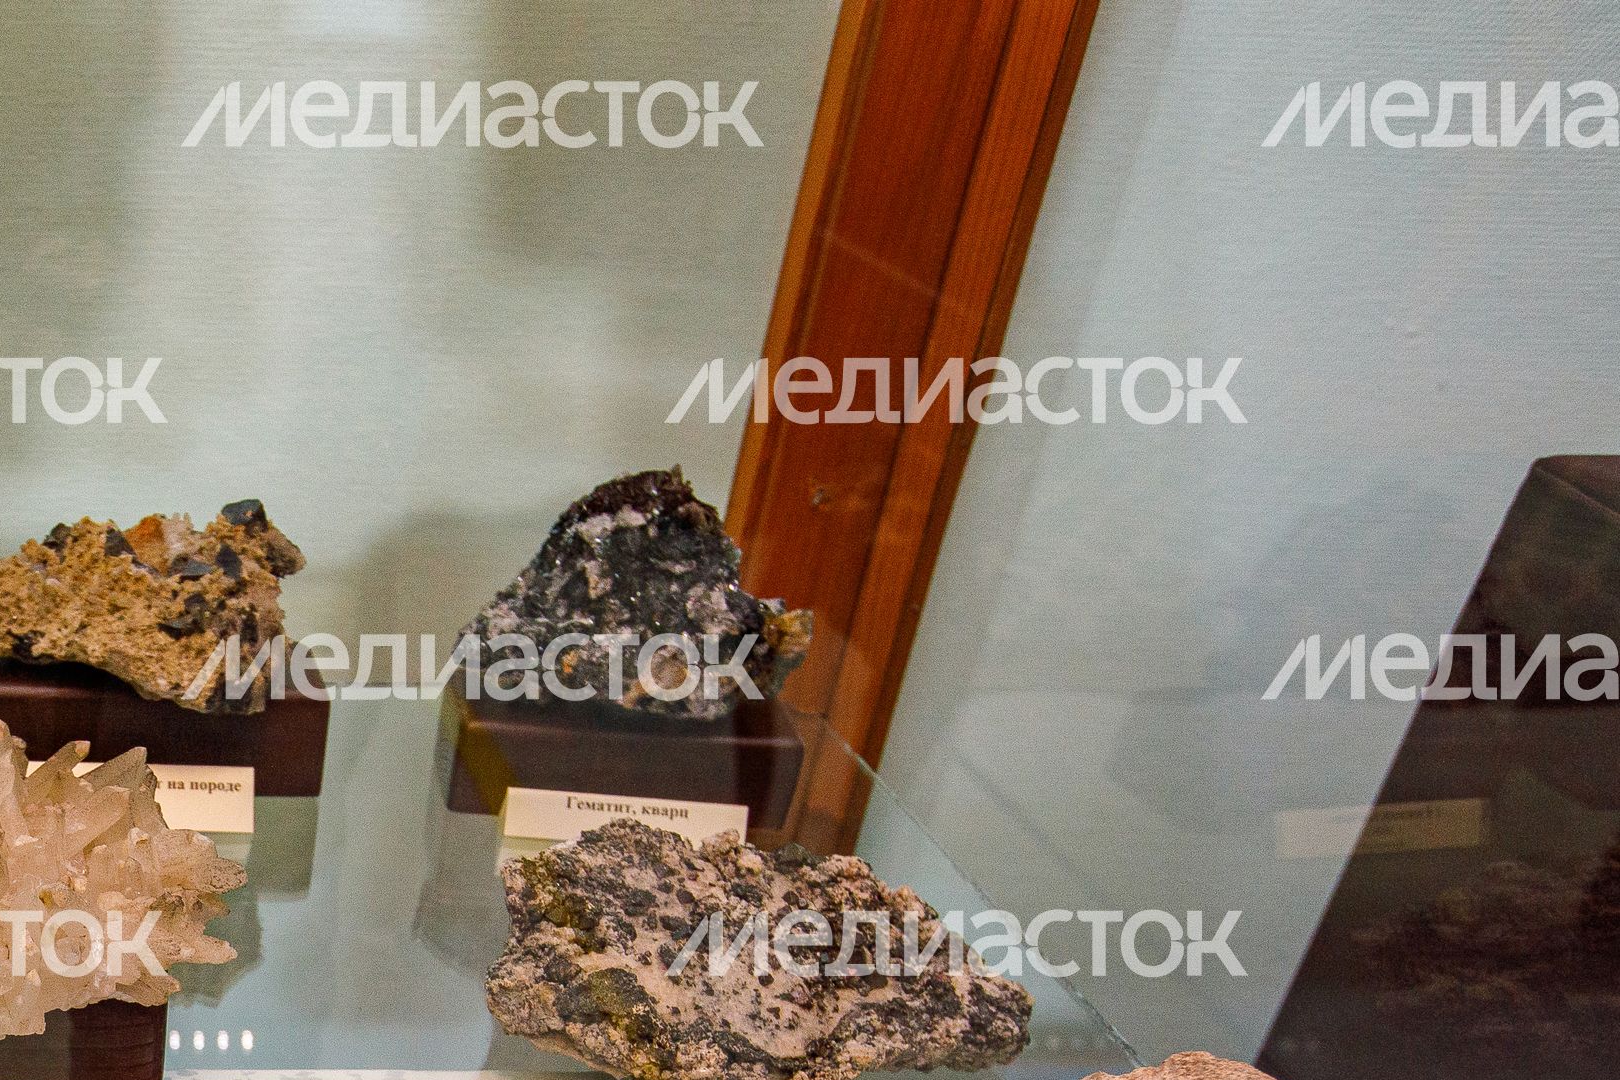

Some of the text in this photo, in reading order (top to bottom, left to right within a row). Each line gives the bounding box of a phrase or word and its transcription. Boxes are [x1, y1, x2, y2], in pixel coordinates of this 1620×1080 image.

[167, 780, 185, 791] на
[189, 780, 242, 794] породе
[566, 796, 636, 814] Гематит,
